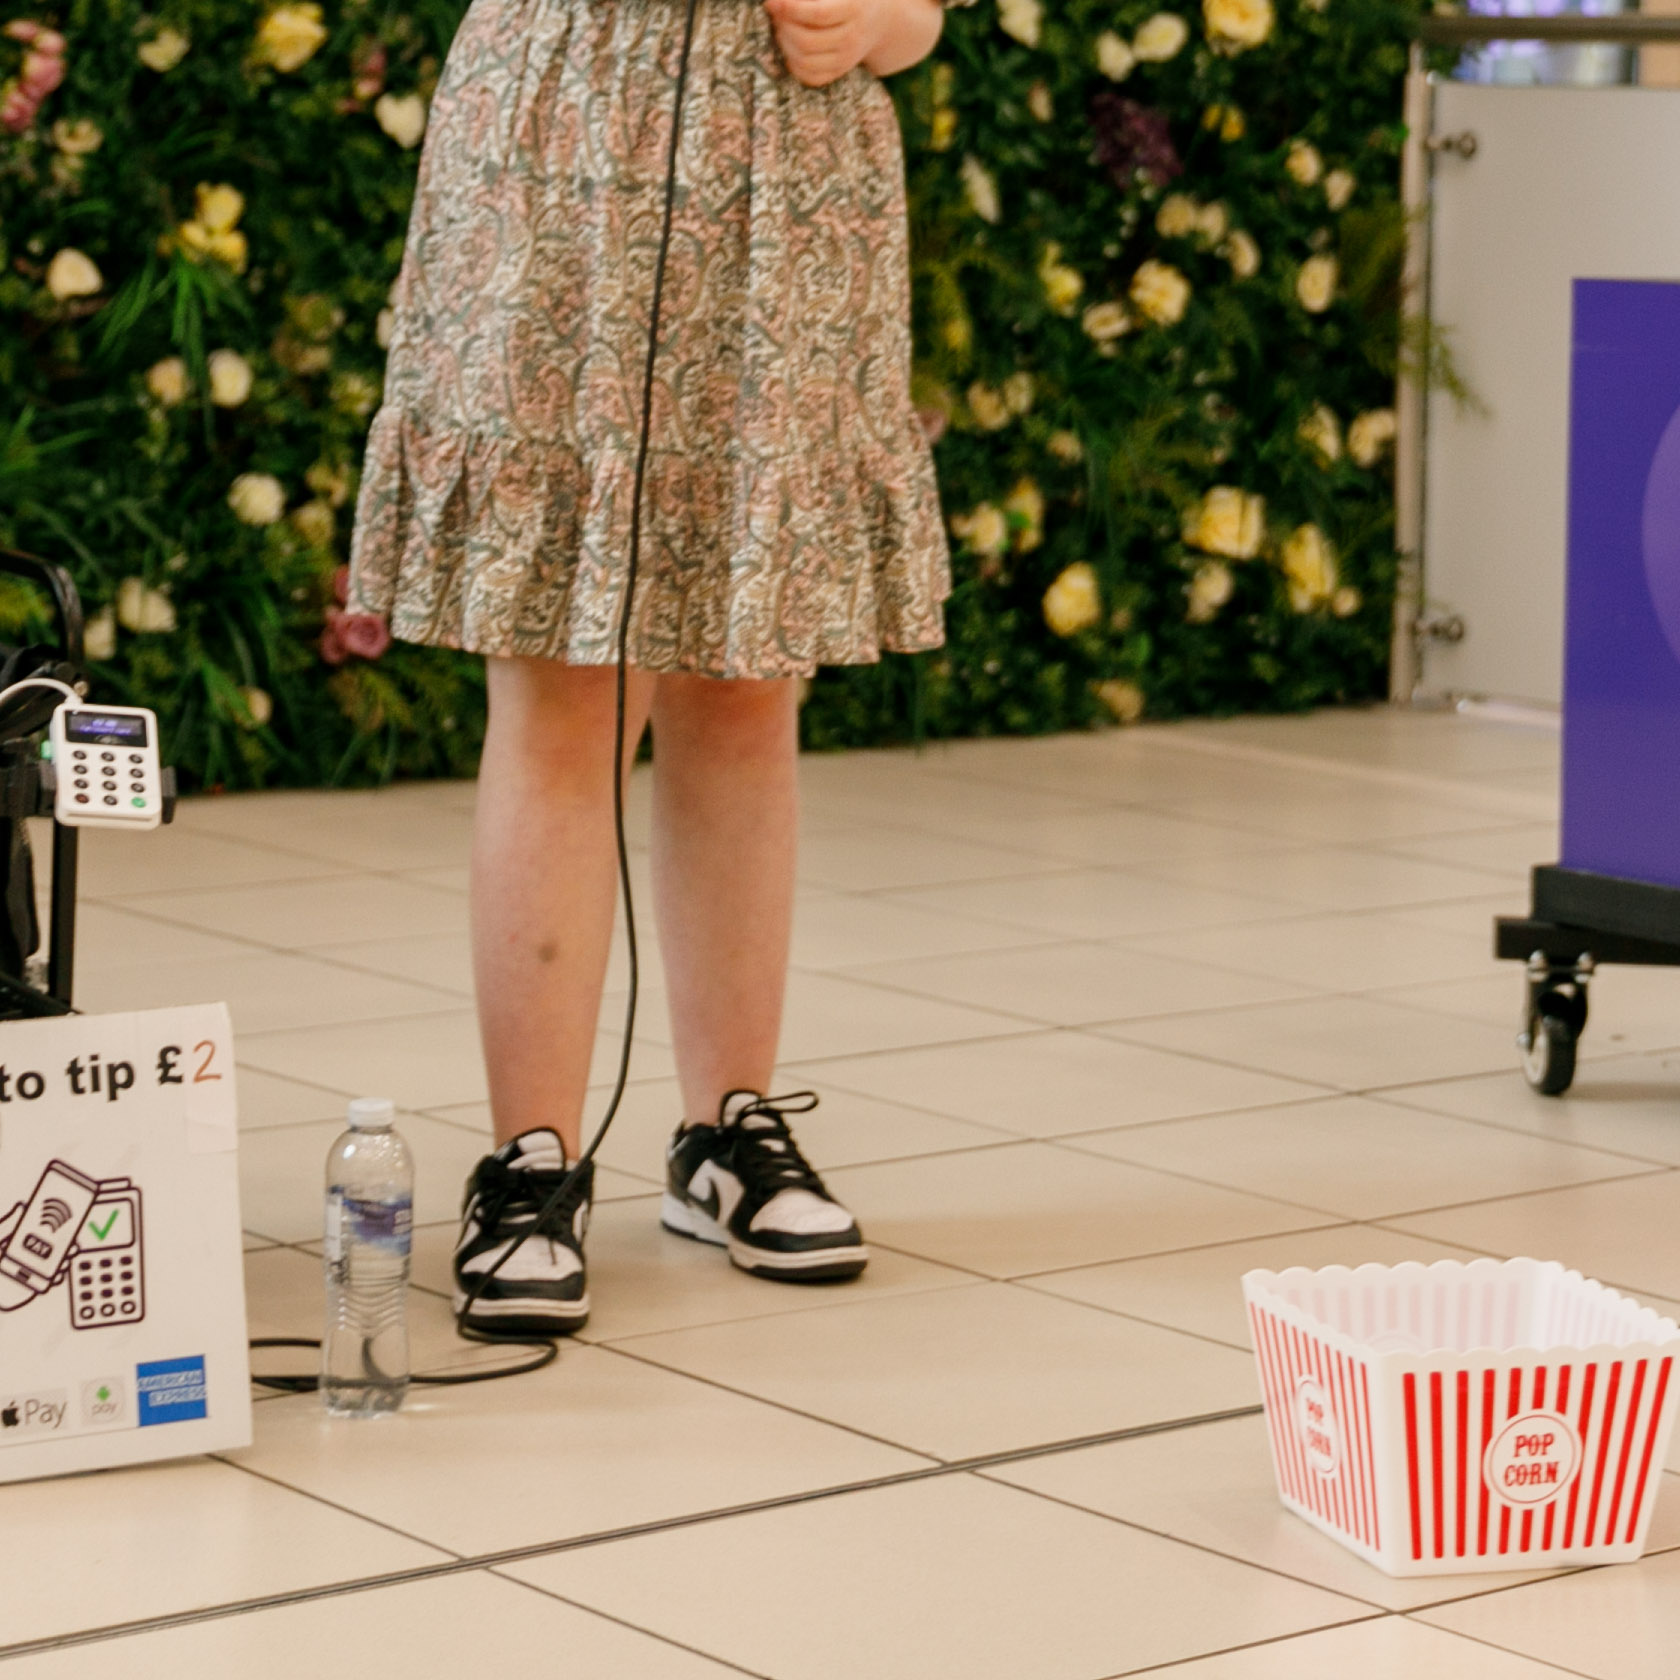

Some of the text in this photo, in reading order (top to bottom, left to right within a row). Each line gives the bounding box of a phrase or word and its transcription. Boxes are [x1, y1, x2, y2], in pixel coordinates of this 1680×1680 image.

[66, 1053, 136, 1102] tip
[23, 1398, 69, 1430] Pay
[1514, 1432, 1555, 1458] POP
[1503, 1460, 1560, 1488] CORN
